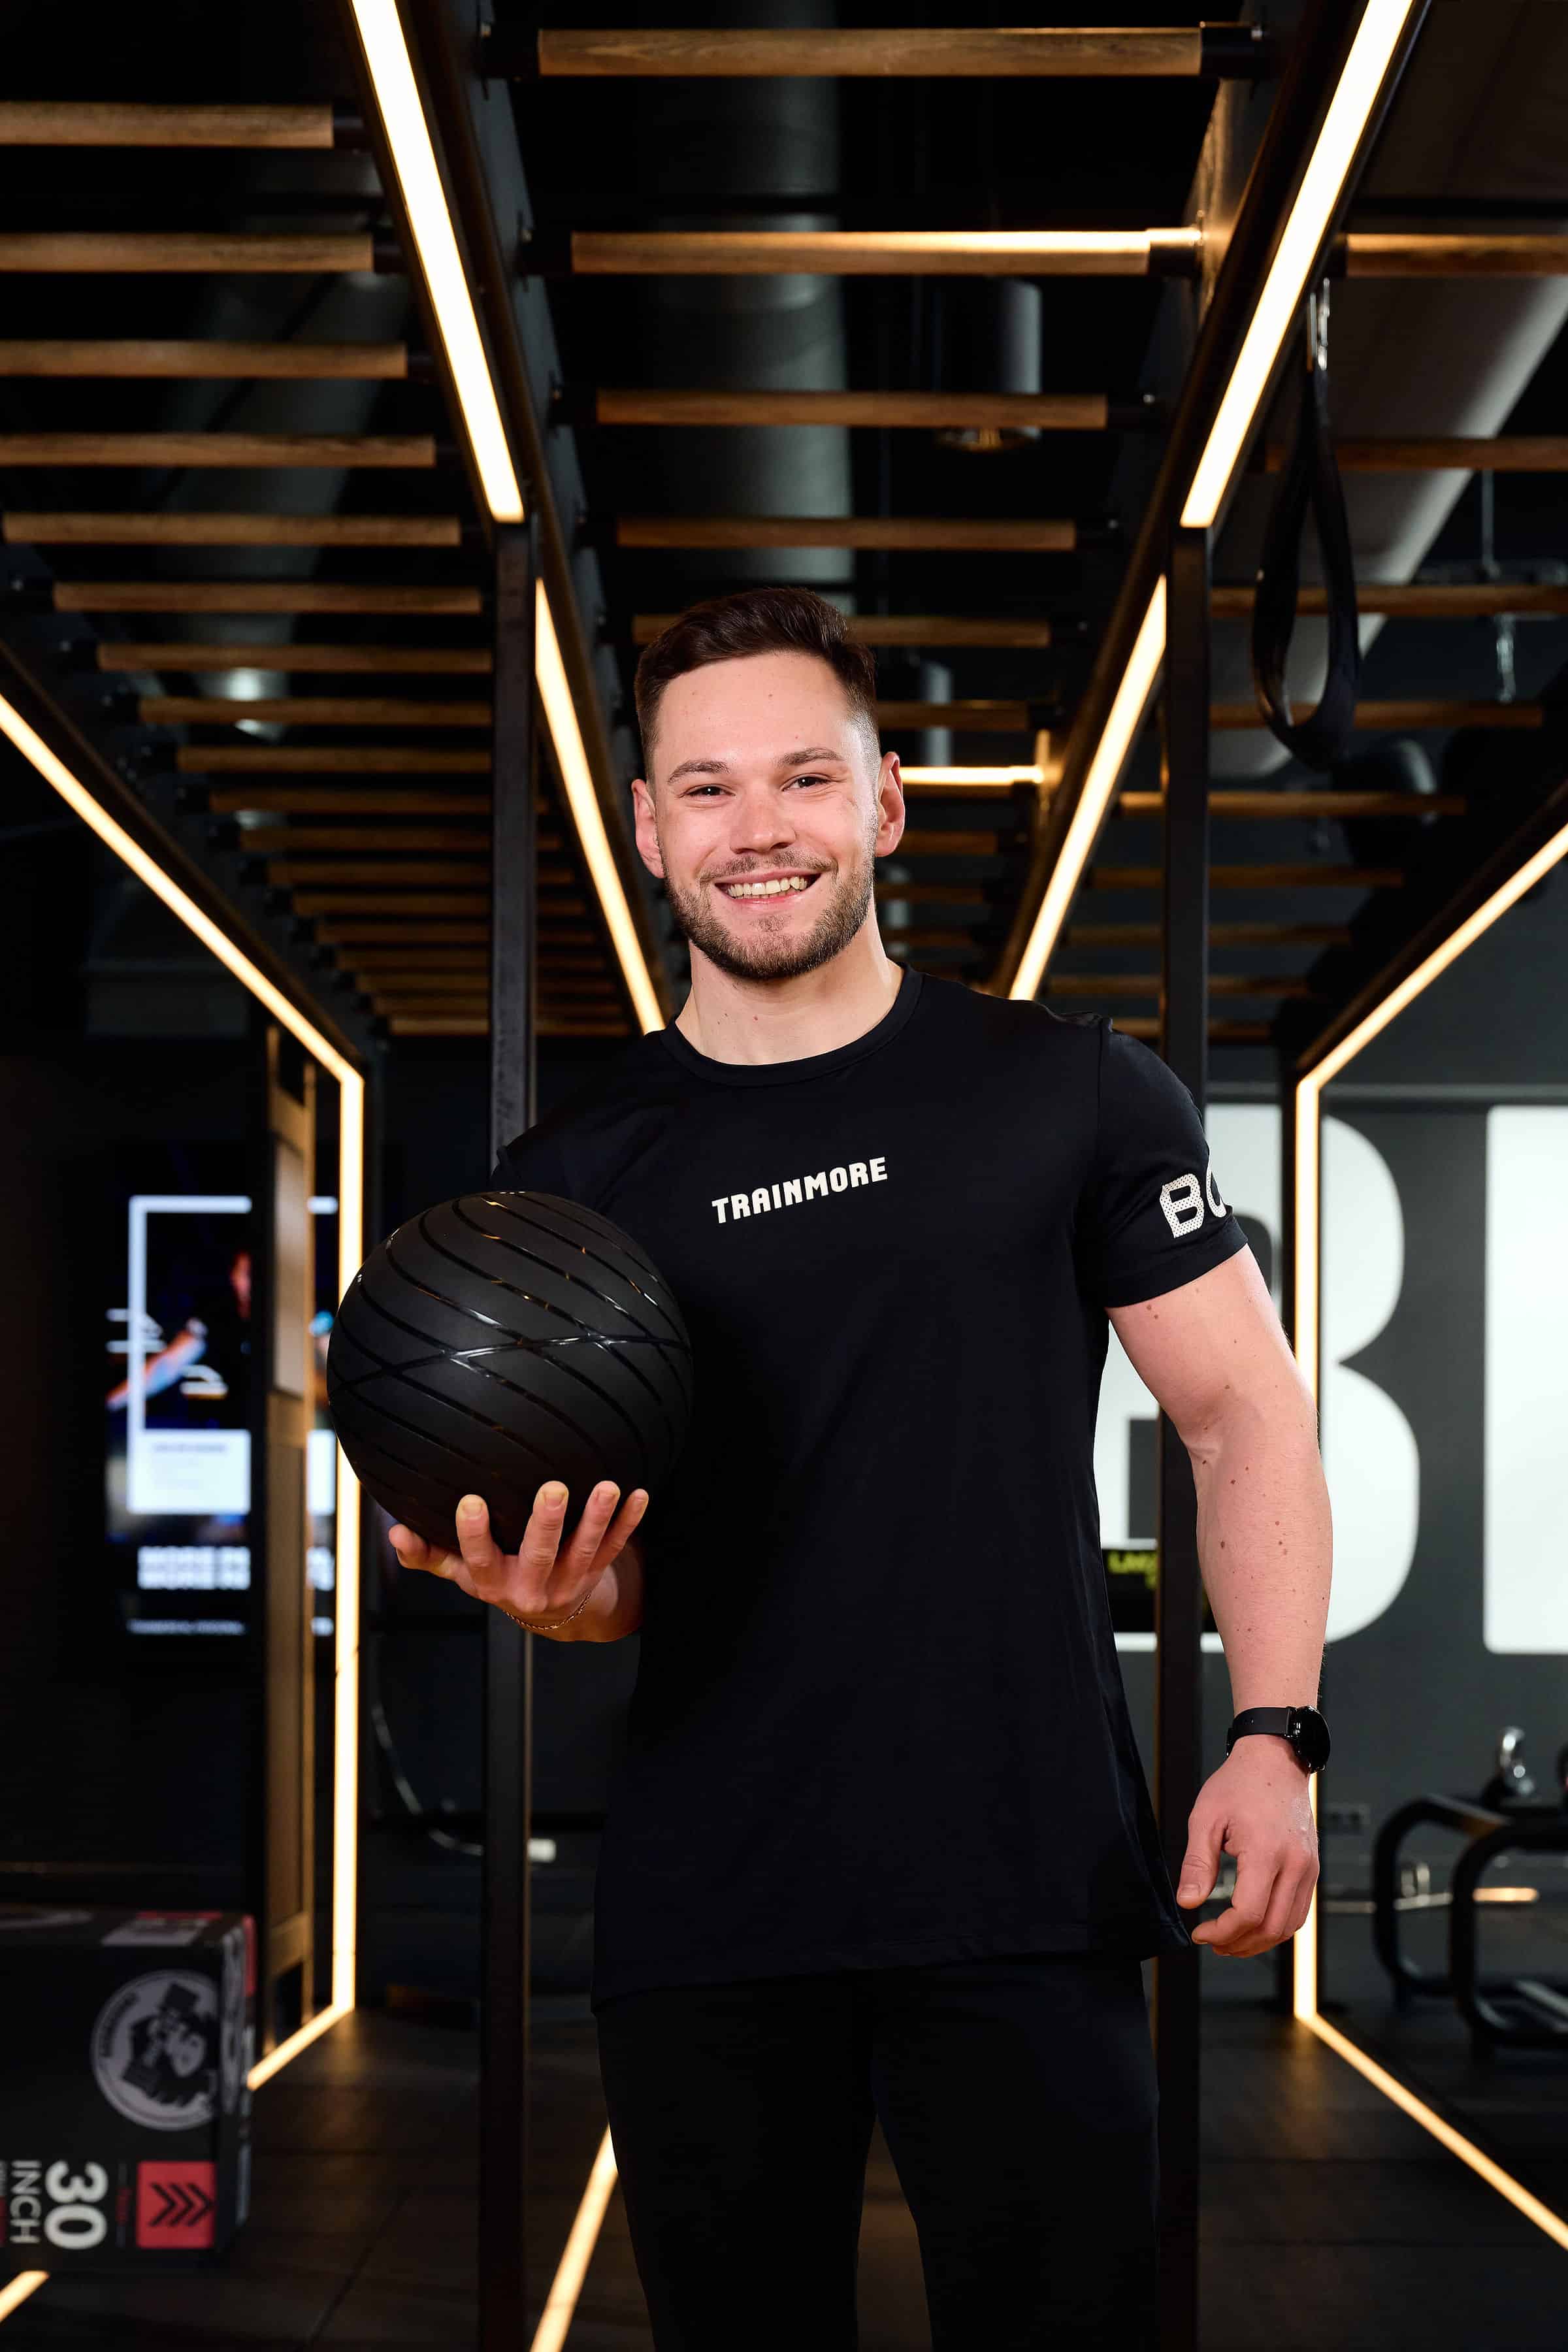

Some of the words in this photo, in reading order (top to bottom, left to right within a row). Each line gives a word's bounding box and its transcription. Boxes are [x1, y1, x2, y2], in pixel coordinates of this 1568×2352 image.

[711, 1156, 888, 1224] TRAINMORE
[10, 2160, 41, 2244] INCH
[44, 2161, 108, 2249] 30
